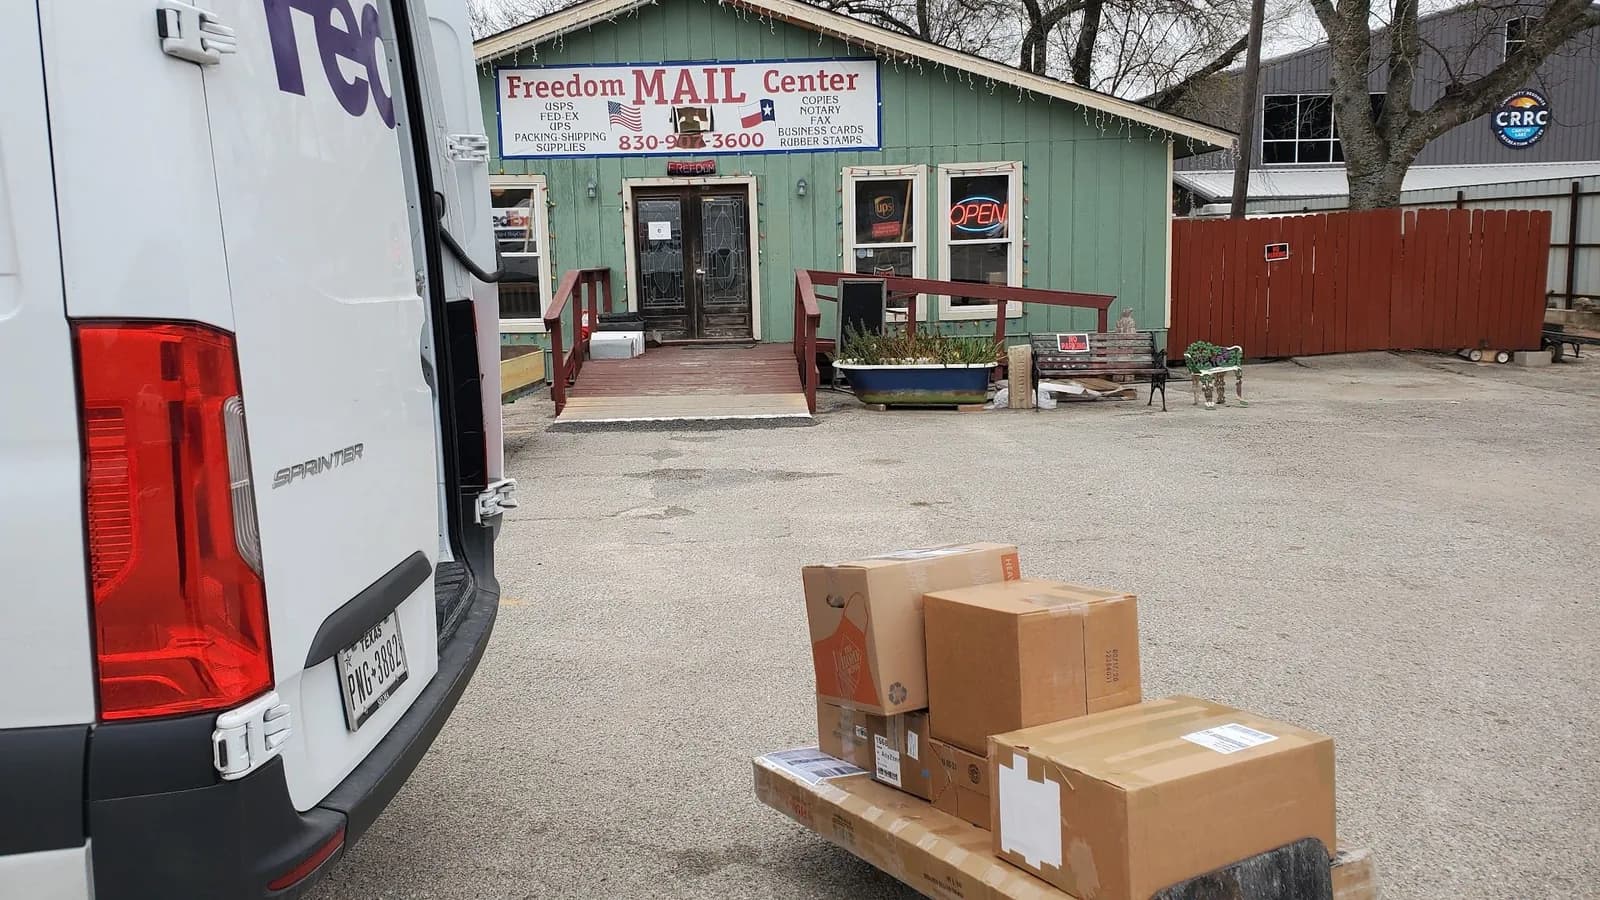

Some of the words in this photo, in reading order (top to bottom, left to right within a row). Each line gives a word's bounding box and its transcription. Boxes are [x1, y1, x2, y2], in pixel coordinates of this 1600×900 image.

[506, 73, 625, 99] Freedom
[631, 67, 747, 106] MAIL
[763, 69, 859, 94] Center
[801, 95, 839, 105] COPIES
[544, 102, 574, 111] USPS
[800, 105, 841, 115] NOTARY
[540, 112, 579, 121] FED-EX
[810, 115, 831, 125] FAX
[1496, 110, 1548, 126] CRRC
[549, 122, 571, 131] UPS
[778, 126, 827, 137] BUSINESS
[830, 125, 864, 135] CARDS
[514, 132, 607, 142] PACKING-SHIPPING
[780, 136, 822, 147] RUBBER
[824, 135, 863, 145] STAMPS
[536, 143, 586, 152] SUPPLIES
[668, 161, 715, 174] FREEDOM
[950, 203, 1008, 225] OPEN
[1068, 335, 1078, 343] NO
[1061, 342, 1086, 350] PARKING
[272, 443, 364, 489] SPRINTER
[361, 625, 382, 652] TEXAS
